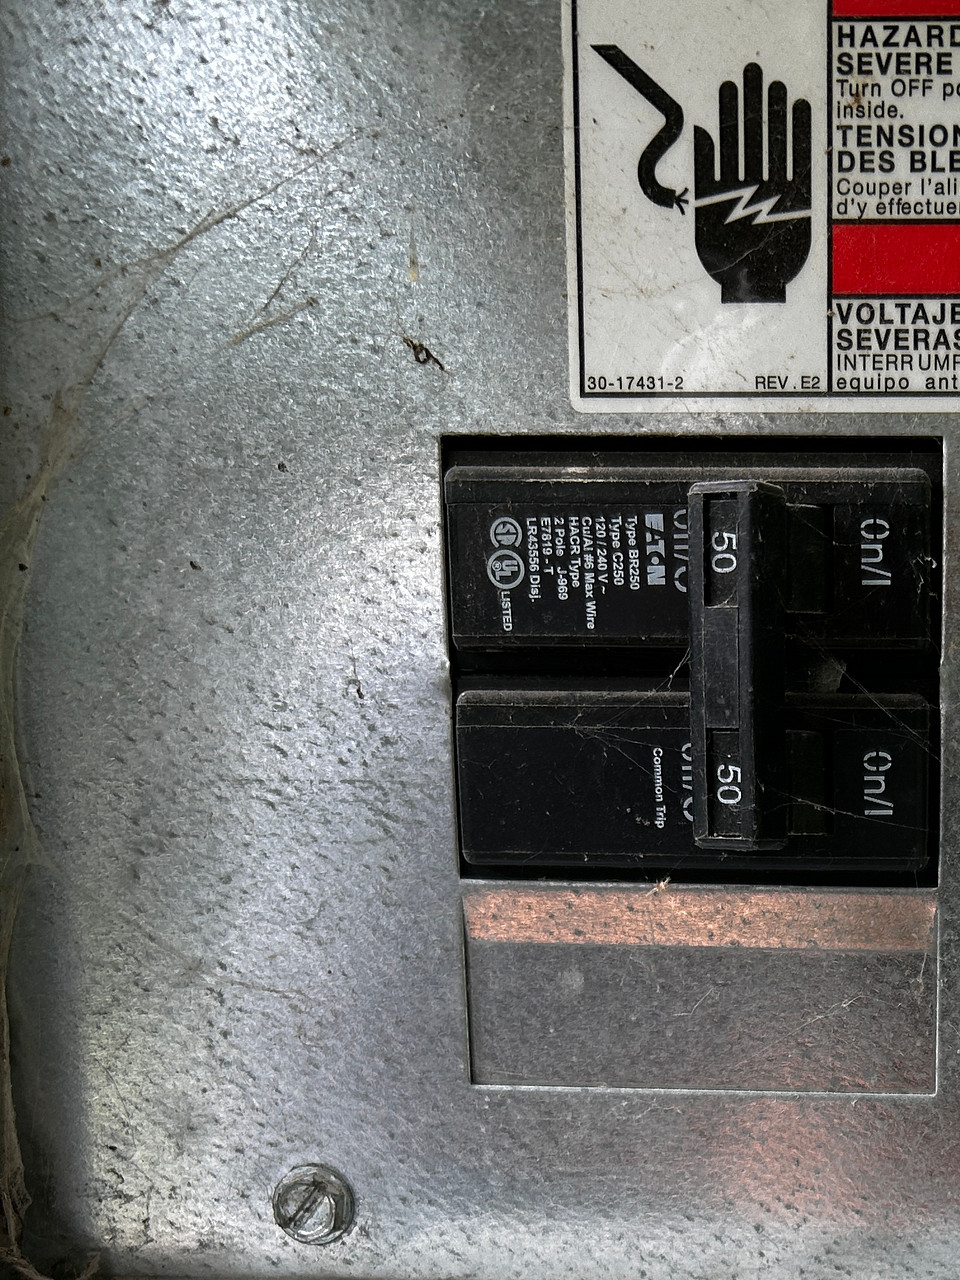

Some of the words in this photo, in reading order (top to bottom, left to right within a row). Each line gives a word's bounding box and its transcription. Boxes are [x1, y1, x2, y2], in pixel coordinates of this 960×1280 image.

[837, 52, 952, 75] SEVERE
[837, 80, 880, 97] Turn
[891, 79, 933, 97] OFF
[837, 103, 904, 119] inside.
[838, 150, 895, 173] DES
[837, 180, 911, 200] Couper
[837, 200, 866, 219] d'y
[588, 376, 683, 390] 30-17431-2
[837, 375, 909, 393] equipo
[569, 517, 580, 555] HACR
[609, 516, 622, 548] Type
[625, 516, 637, 546] Type
[645, 514, 665, 585] EATON
[712, 528, 737, 573] 50
[569, 558, 581, 587] Type
[613, 552, 624, 585] C250
[629, 550, 640, 589] BR250
[585, 573, 595, 598] Max
[501, 591, 512, 631] LISTED
[586, 601, 596, 629] Wire
[653, 748, 663, 801] Common
[717, 765, 741, 804] 50
[655, 805, 666, 828] Trip
